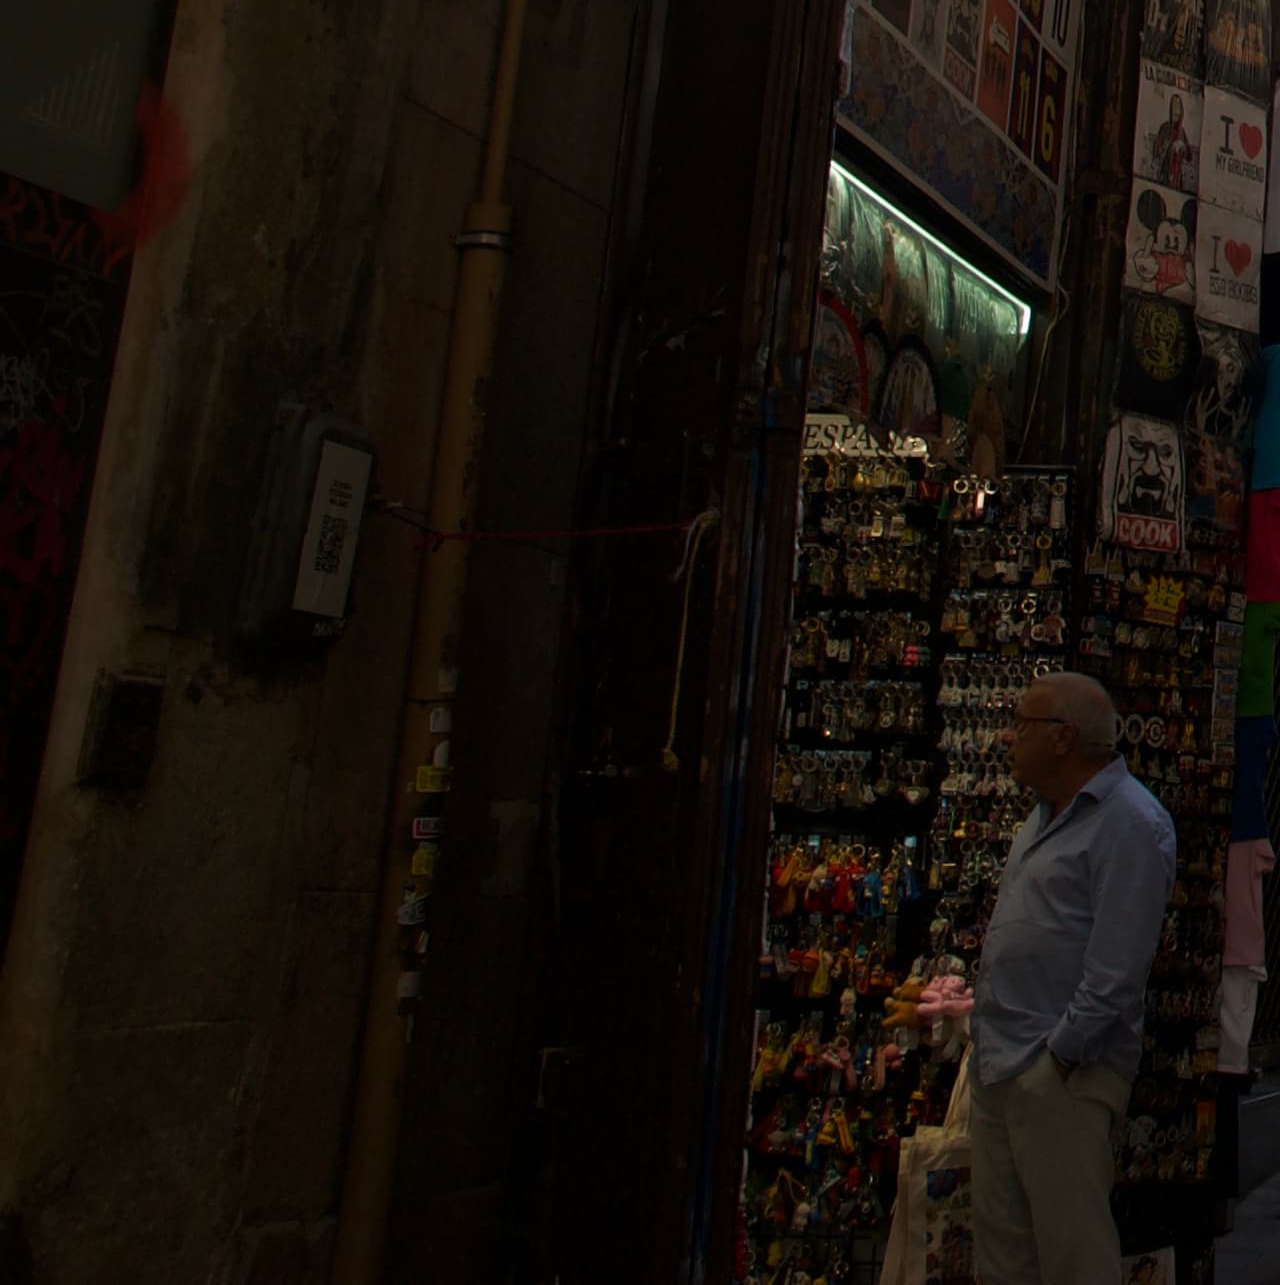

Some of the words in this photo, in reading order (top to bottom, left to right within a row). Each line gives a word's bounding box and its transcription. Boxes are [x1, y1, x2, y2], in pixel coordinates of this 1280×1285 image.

[1040, 93, 1057, 163] 6
[1220, 115, 1234, 155] I
[1209, 235, 1222, 274] I
[1118, 517, 1176, 547] COOK
